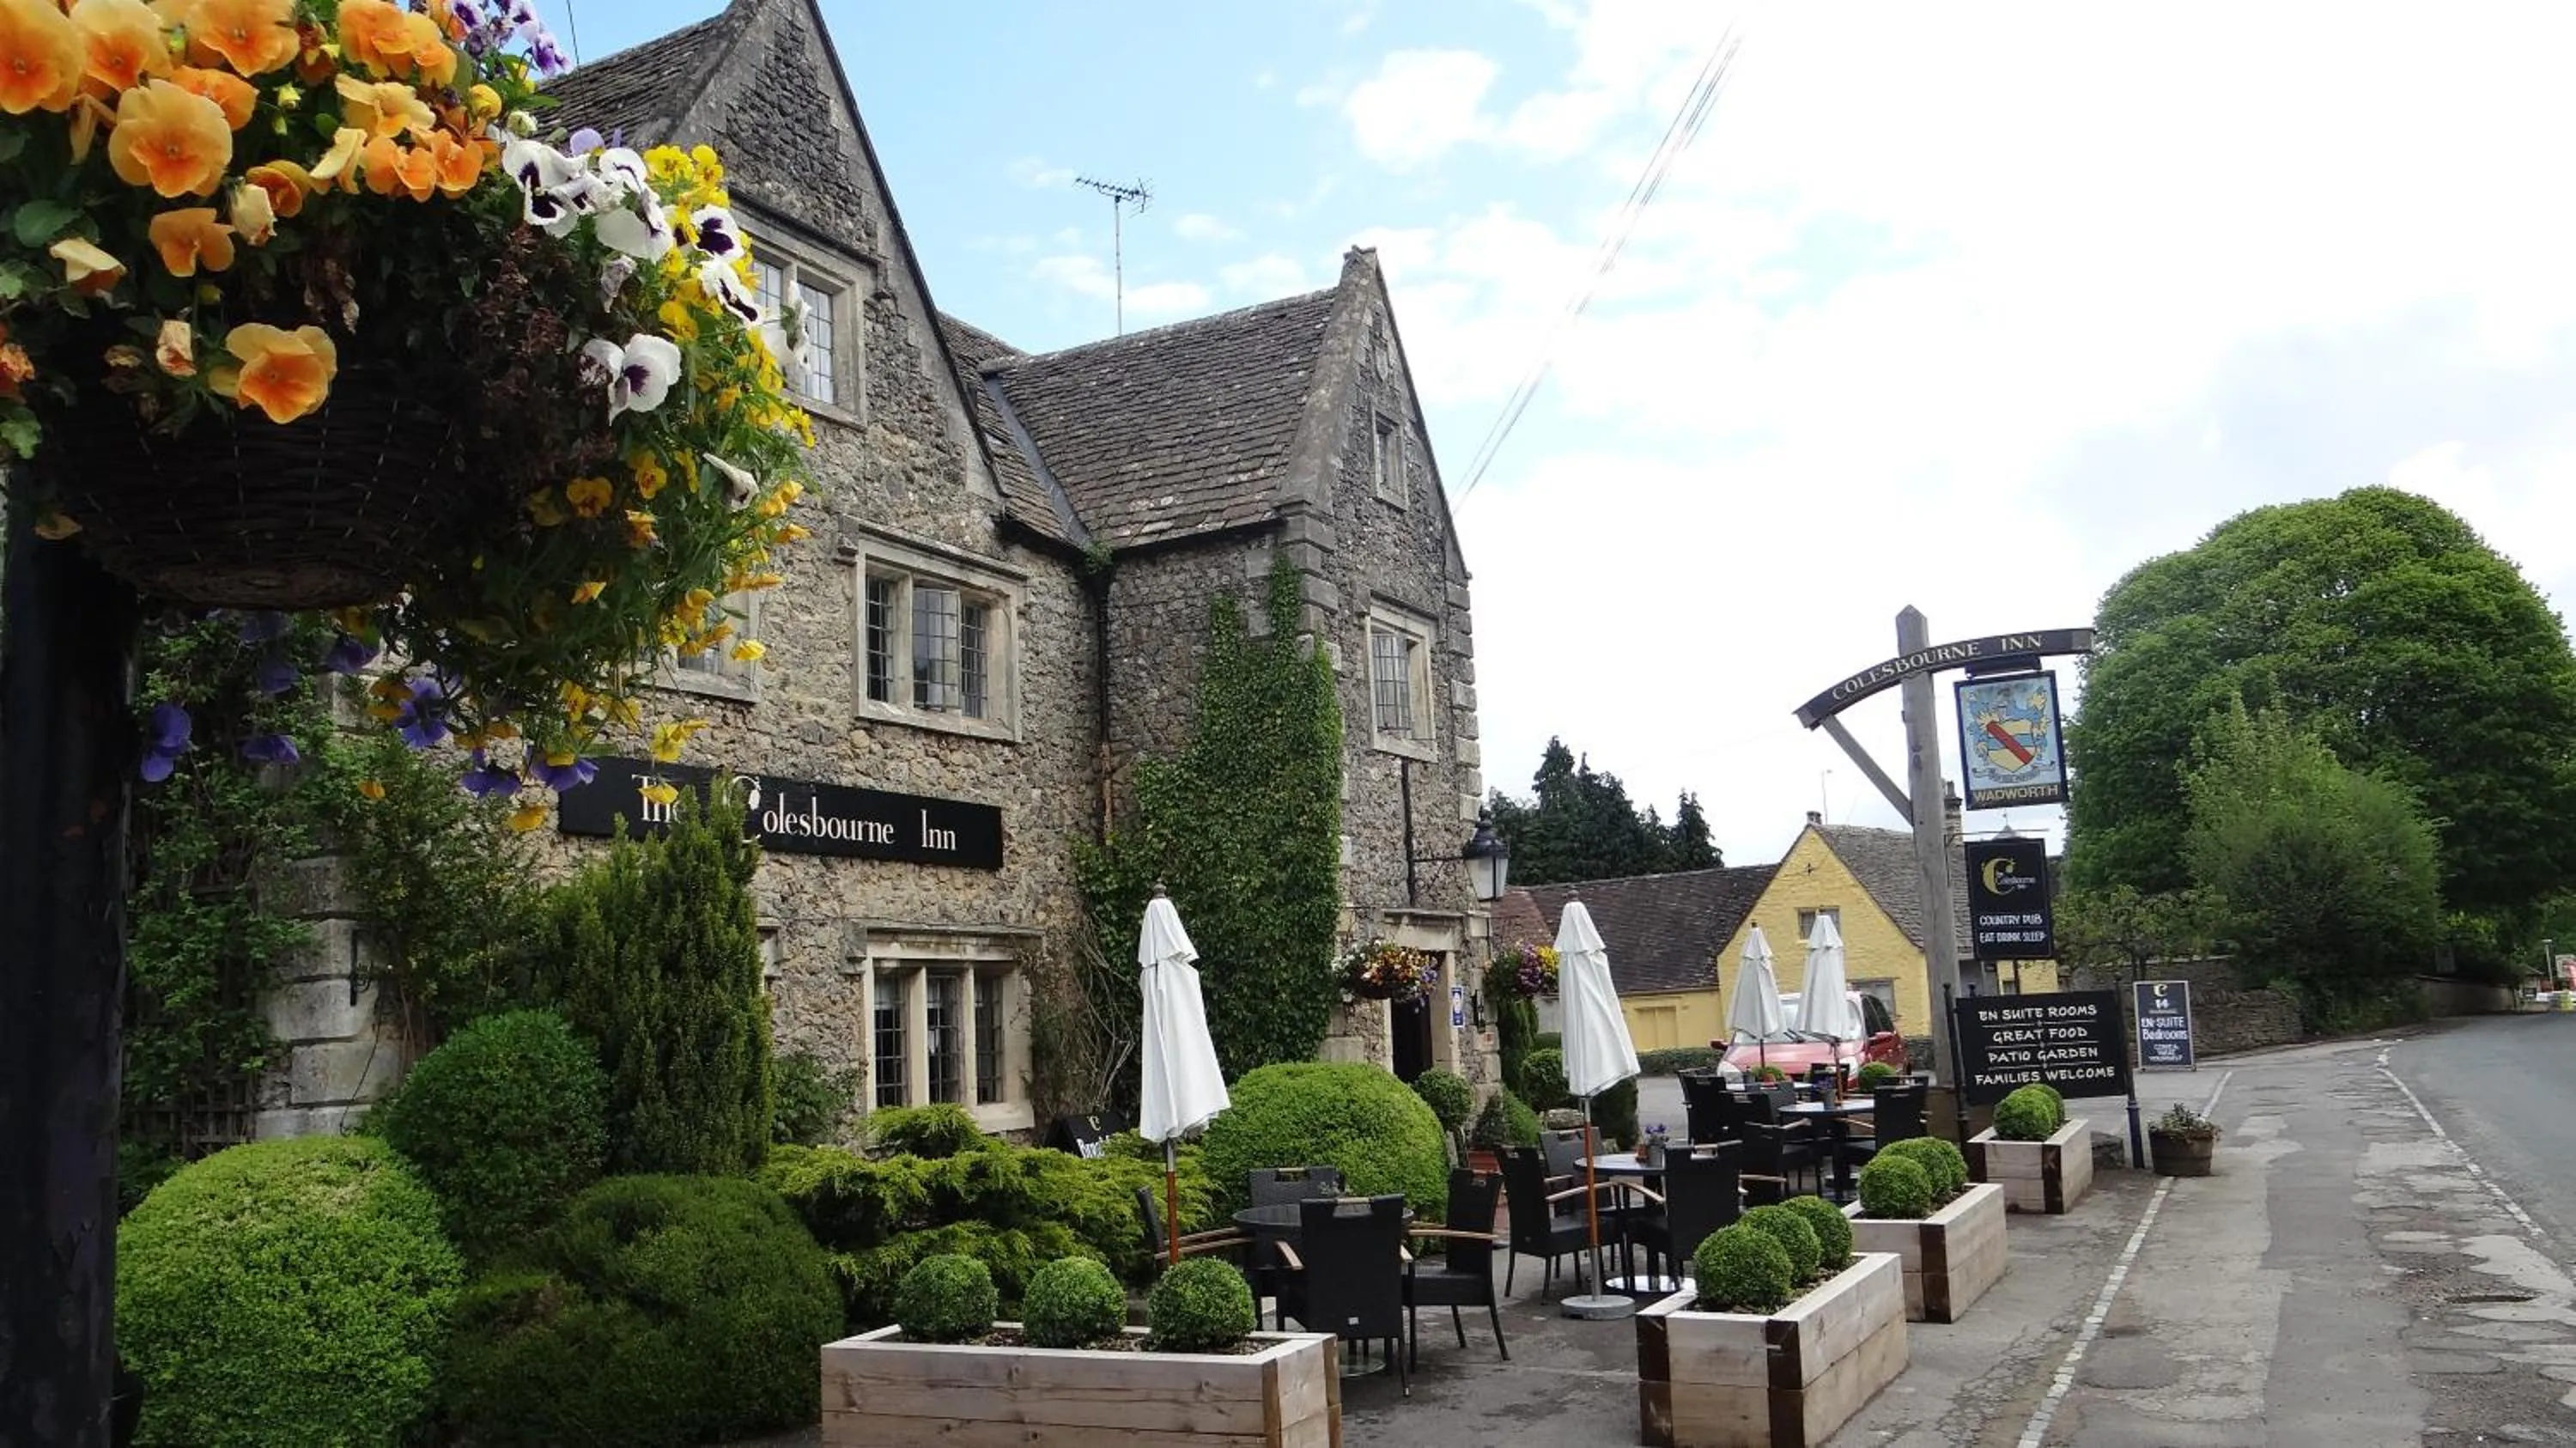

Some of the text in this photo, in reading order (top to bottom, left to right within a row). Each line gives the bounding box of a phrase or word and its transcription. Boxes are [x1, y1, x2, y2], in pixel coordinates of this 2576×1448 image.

[1832, 634, 2043, 700] COLESBOURNE INN
[1975, 784, 2058, 802] WADWORTH
[920, 808, 957, 851] Inn
[1979, 913, 2043, 926] COUNTRY PUB
[1978, 1004, 2098, 1020] EN SUITE ROOMS
[1992, 1026, 2087, 1043] GREAT FOOD
[1988, 1047, 2098, 1063] PATIO GARDEN
[1975, 1066, 2115, 1085] FAMILIES WELCOME
